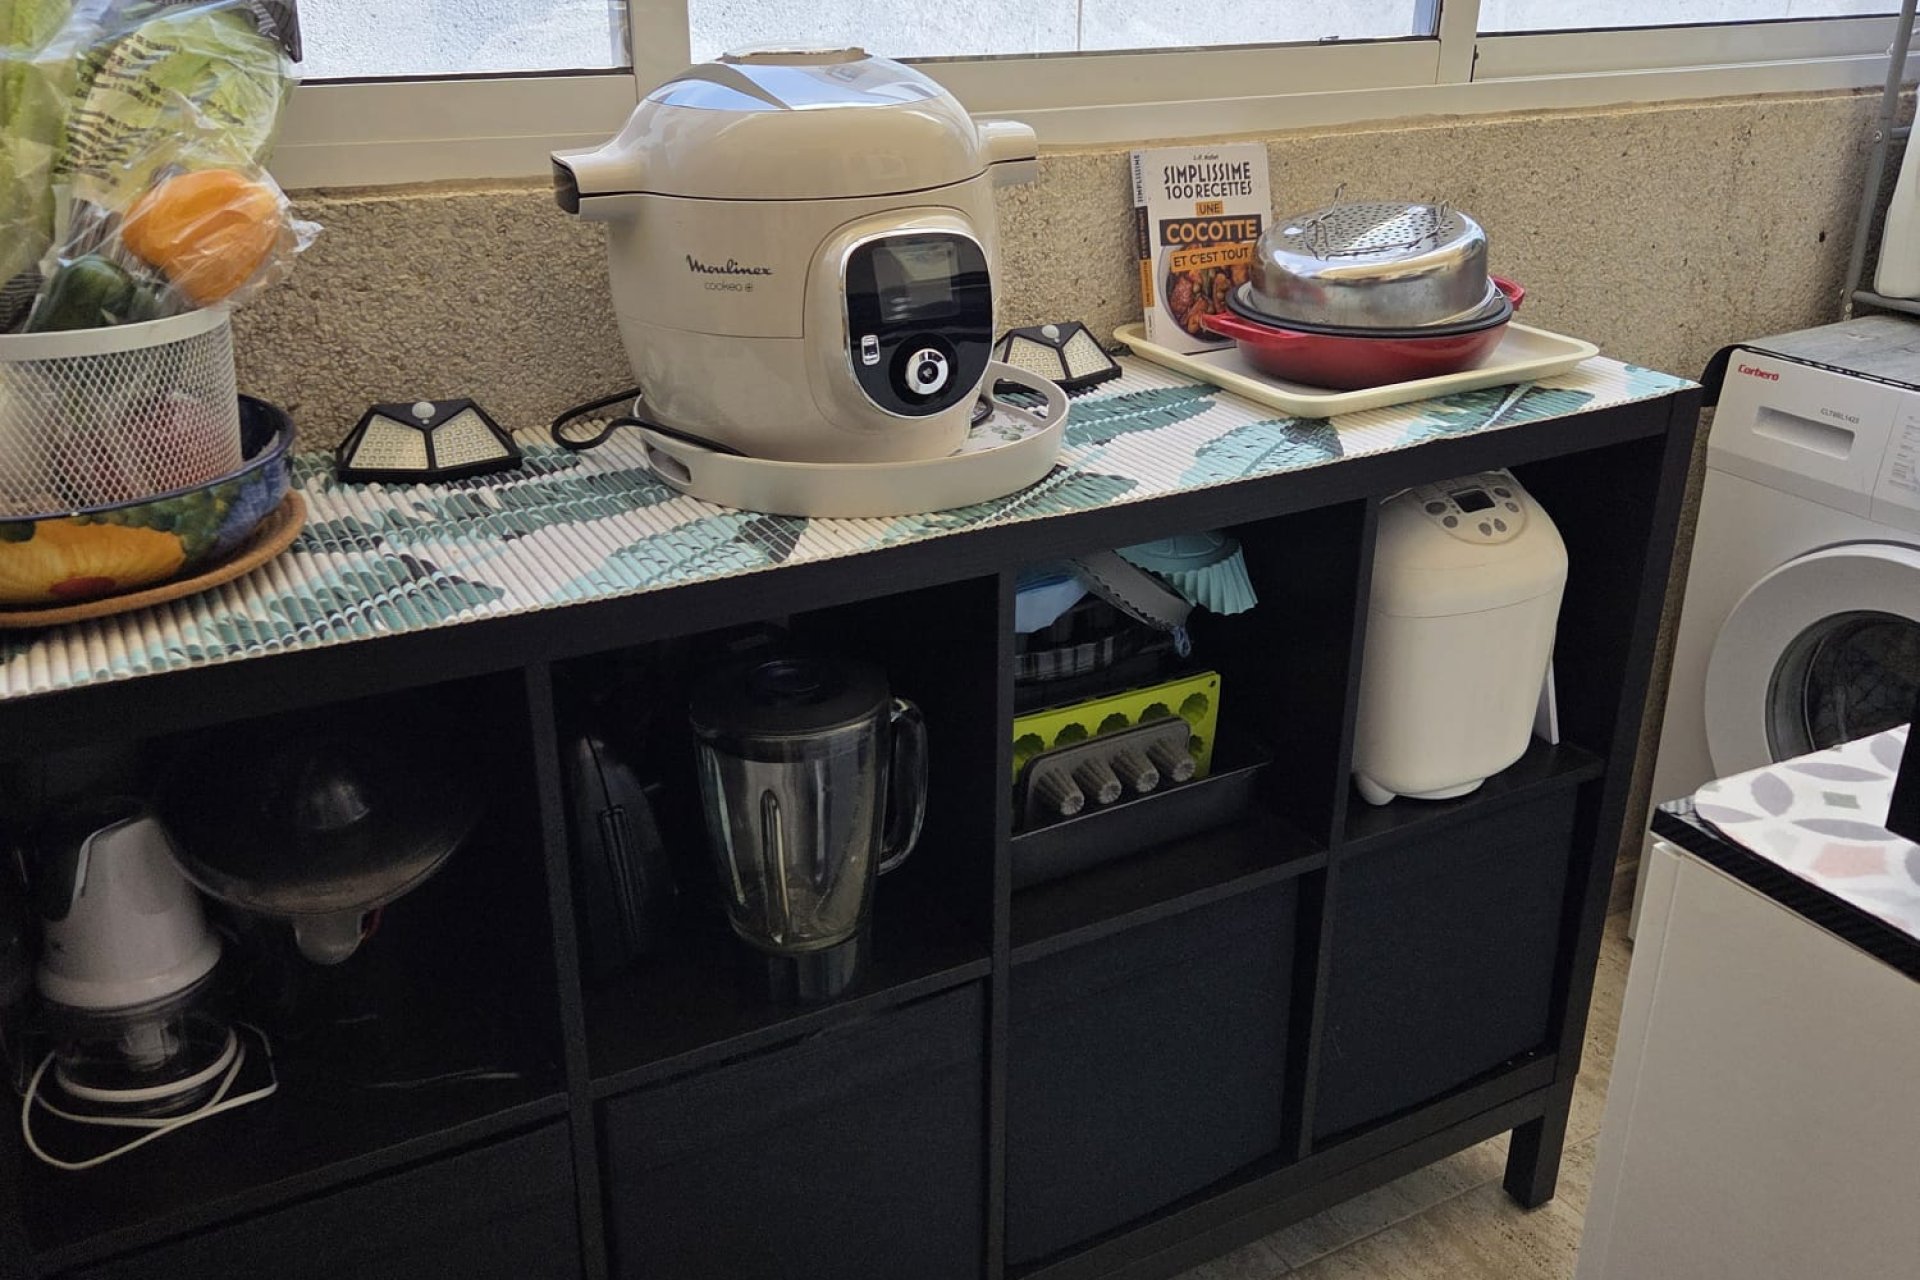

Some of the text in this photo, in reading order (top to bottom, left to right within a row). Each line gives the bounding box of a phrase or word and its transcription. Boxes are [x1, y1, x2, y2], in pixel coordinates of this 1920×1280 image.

[1164, 161, 1251, 185] SIMPLISSIME
[1165, 180, 1252, 200] 100 RECETTES
[1199, 203, 1220, 215] UNE
[1166, 219, 1258, 244] COCOTTE
[686, 254, 774, 275] Moulinex
[1173, 247, 1248, 268] ET C'EST TOUT
[704, 281, 743, 292] cookeo
